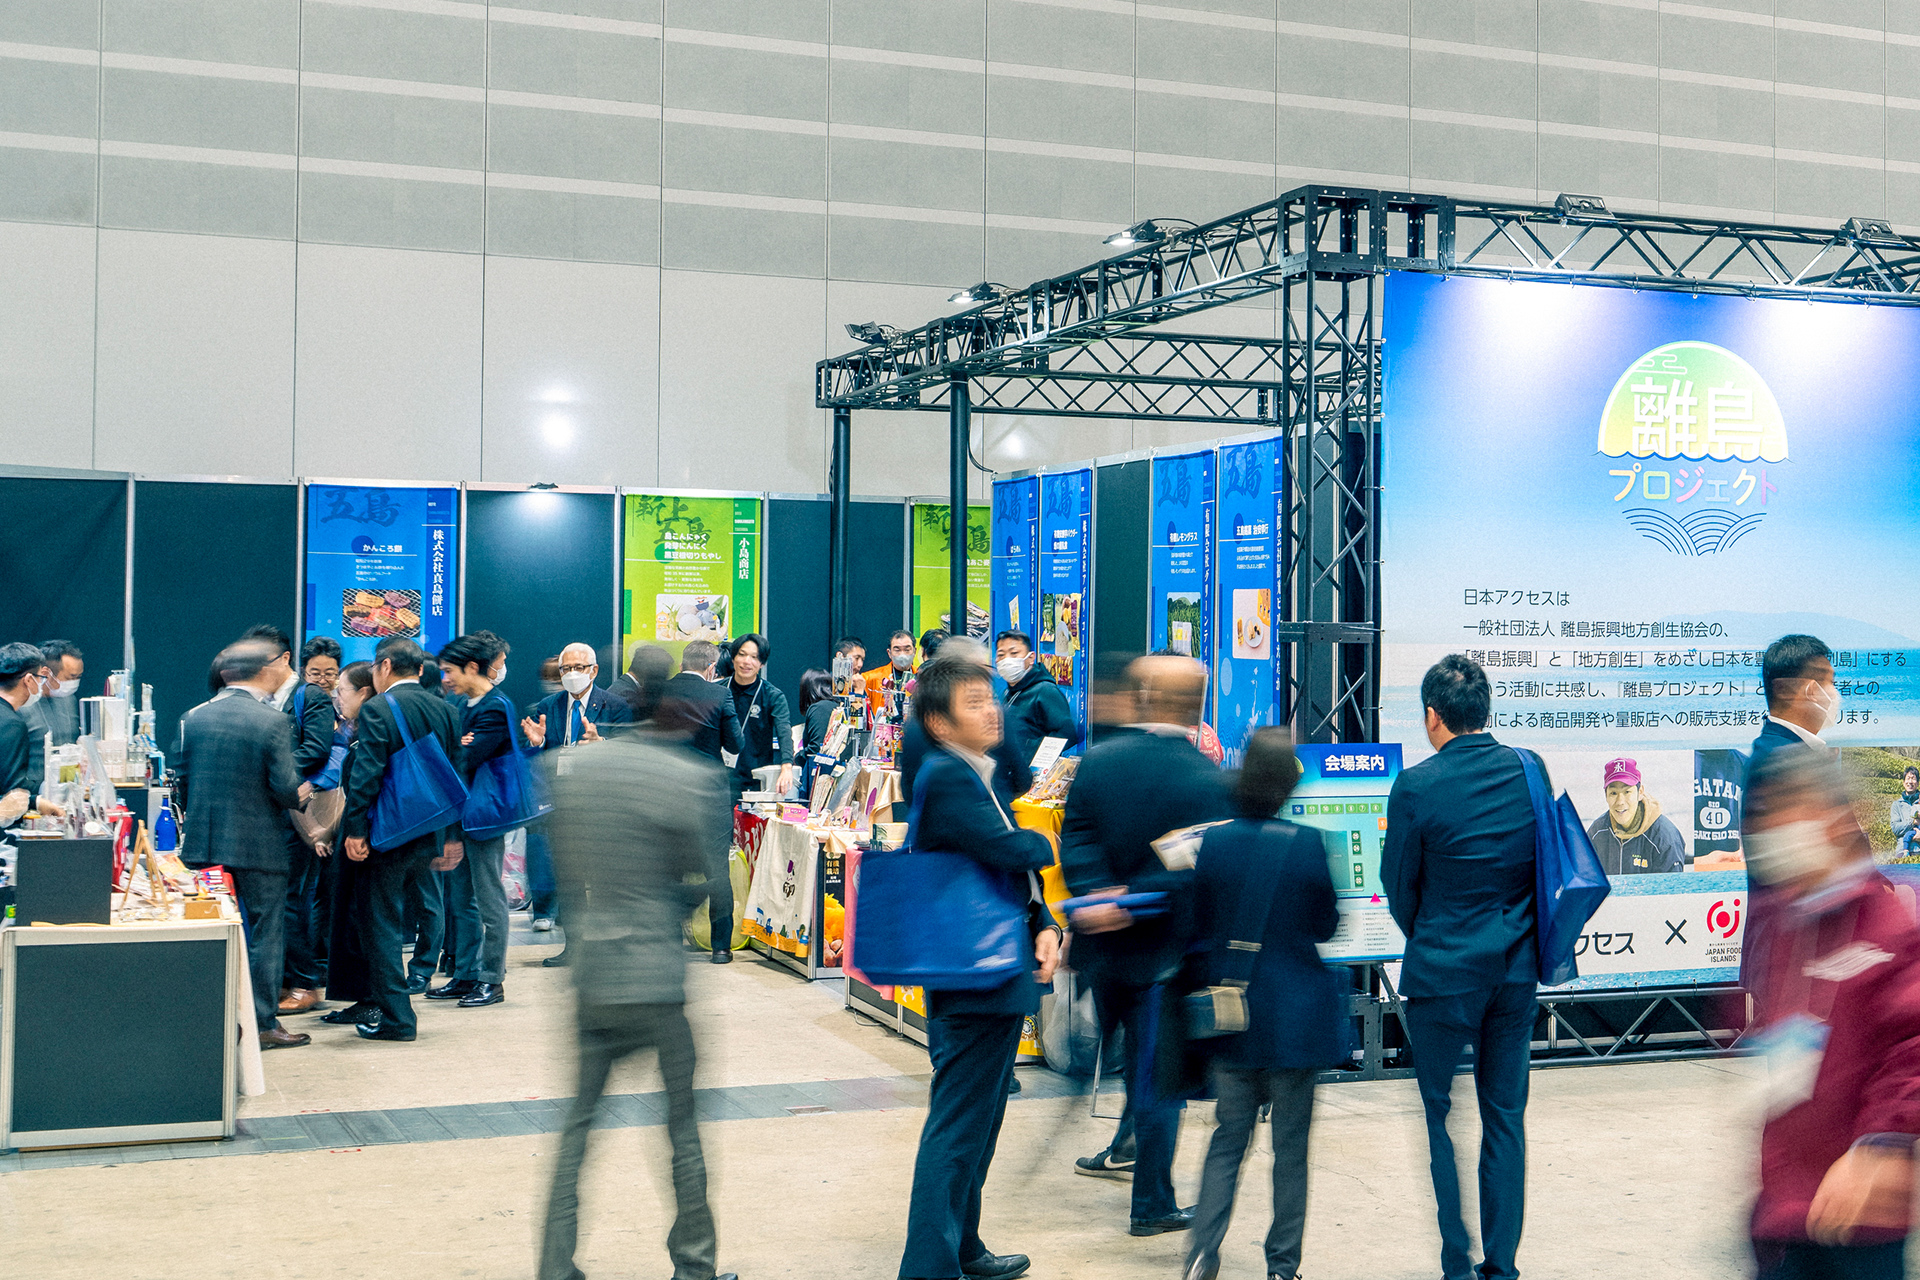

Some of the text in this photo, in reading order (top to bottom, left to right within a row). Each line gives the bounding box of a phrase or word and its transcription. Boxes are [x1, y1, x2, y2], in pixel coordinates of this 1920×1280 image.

[1630, 376, 1764, 459] 離島
[1608, 462, 1778, 506] プロジェクト
[738, 537, 750, 580] 小島商店
[1464, 588, 1570, 606] 日本アクセスは
[1463, 619, 1729, 639] 一般社団法人 離島振興地方創生協会の、
[1324, 754, 1385, 772] 会場案内
[1706, 811, 1723, 825] 40
[1705, 948, 1726, 956] JAPAN
[1710, 955, 1737, 963] ISLANDS
